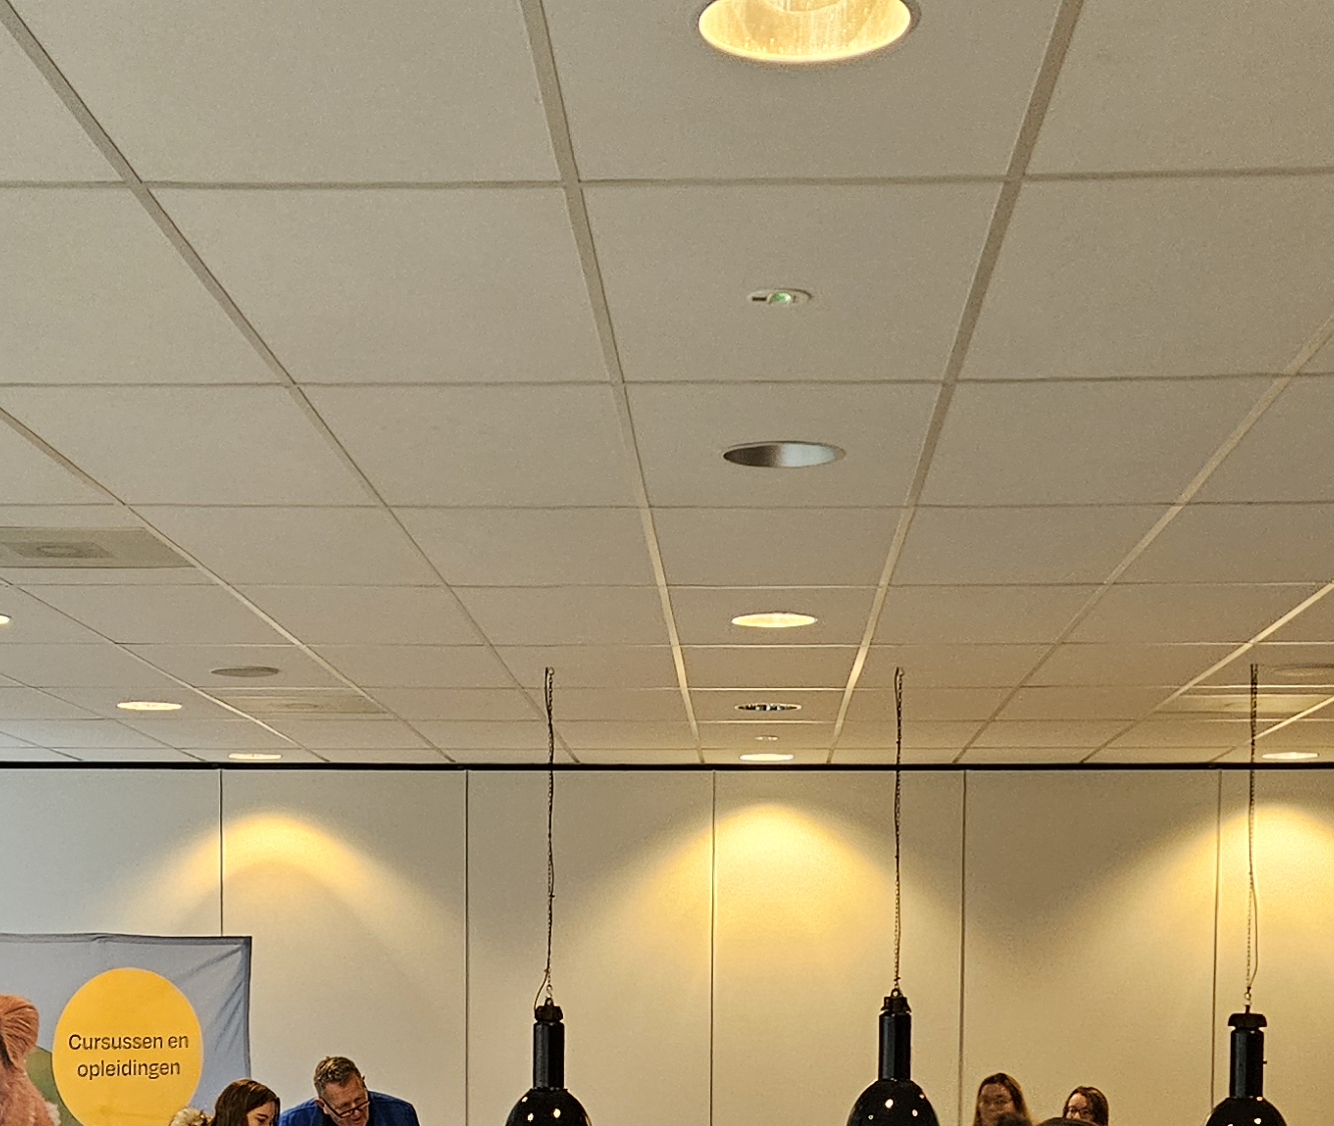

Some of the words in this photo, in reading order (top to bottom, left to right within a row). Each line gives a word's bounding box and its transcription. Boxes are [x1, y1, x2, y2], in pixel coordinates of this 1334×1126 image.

[69, 1034, 163, 1050] Cursussen
[168, 1036, 189, 1048] en
[77, 1059, 180, 1080] opleidingen
